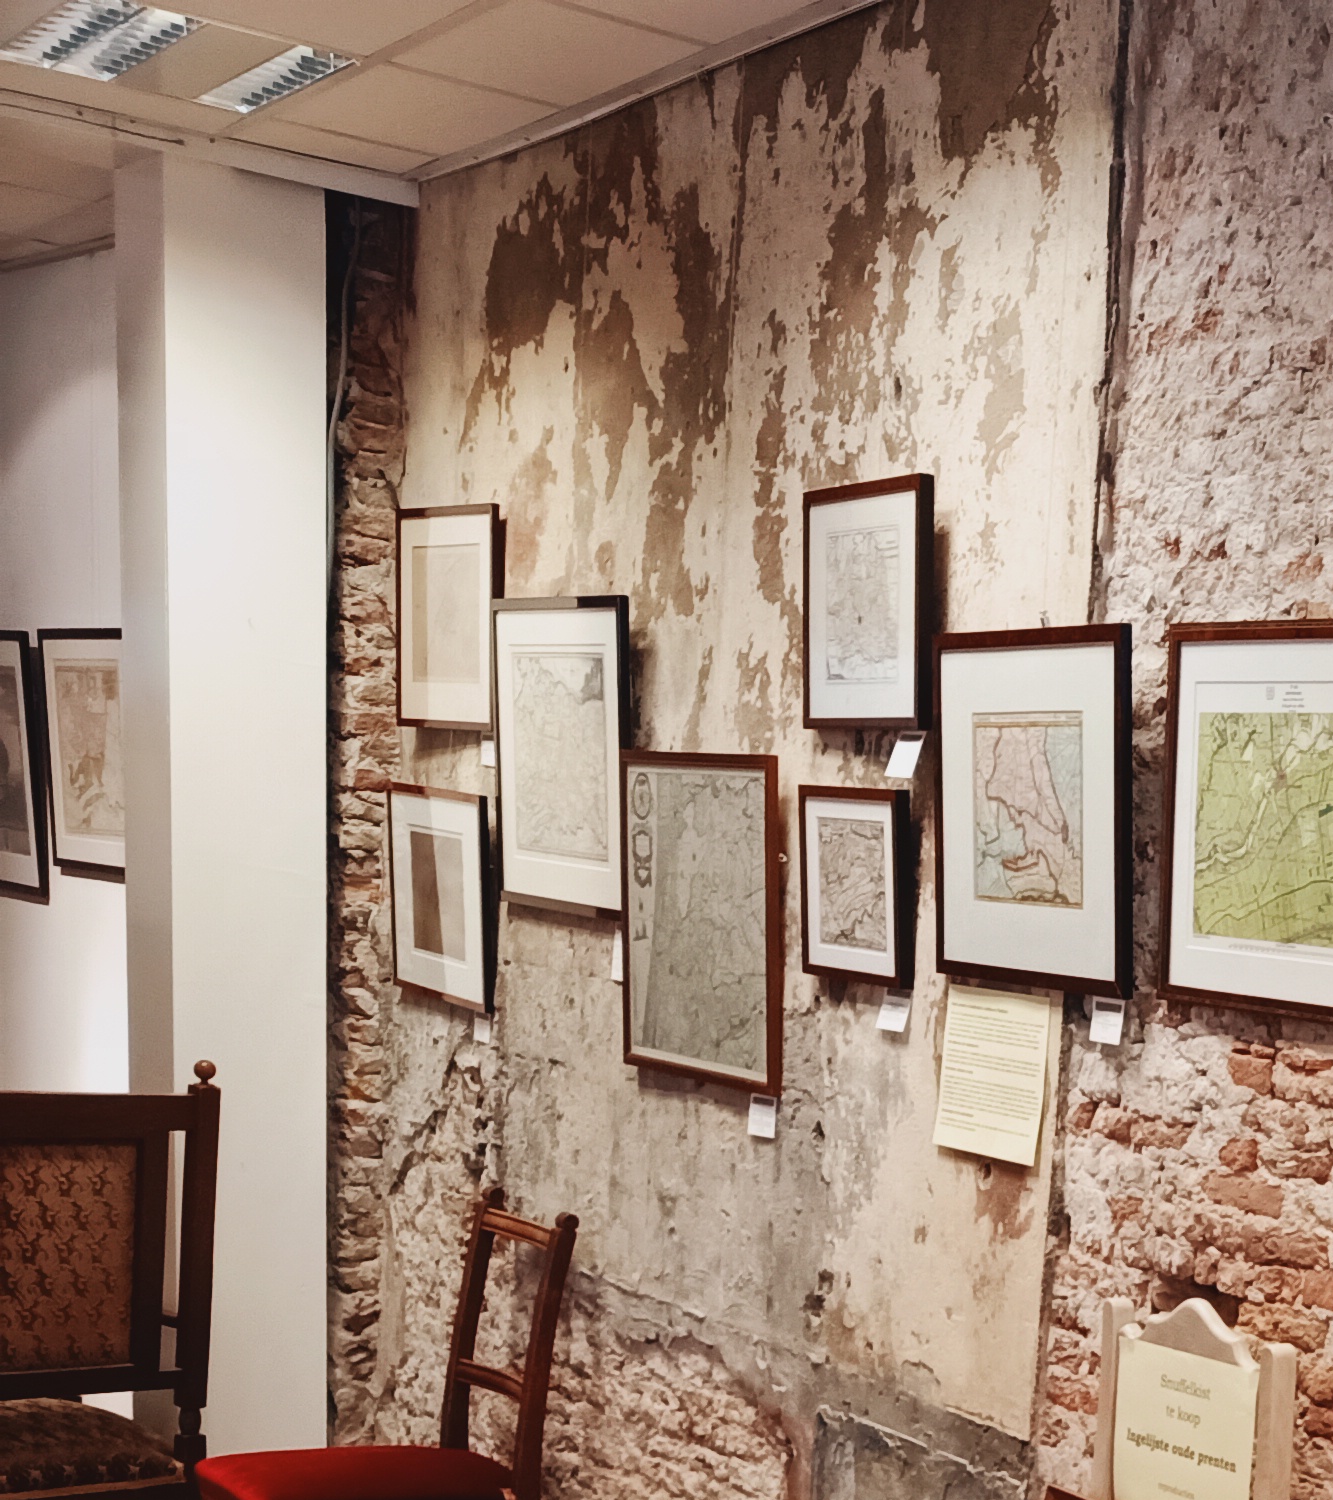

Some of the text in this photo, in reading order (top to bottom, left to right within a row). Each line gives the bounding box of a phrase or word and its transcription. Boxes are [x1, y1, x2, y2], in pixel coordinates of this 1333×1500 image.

[1166, 1405, 1201, 1428] te koop
[1126, 1427, 1237, 1473] Ingelijste oude prenten
